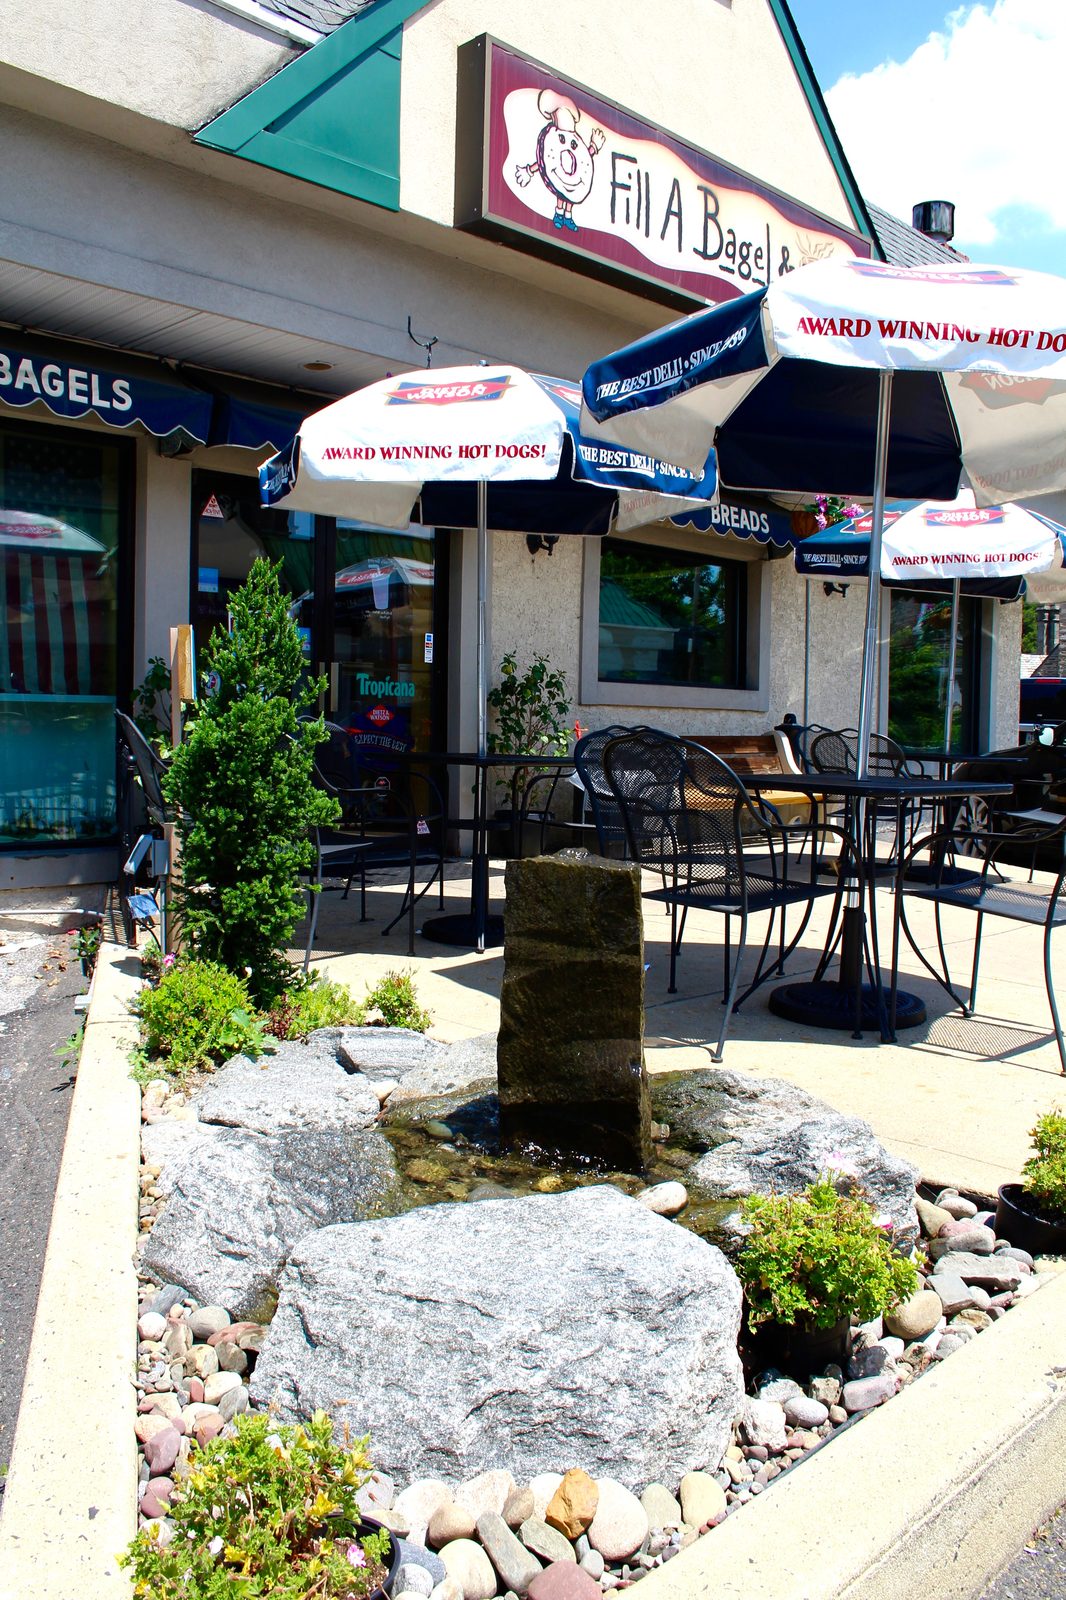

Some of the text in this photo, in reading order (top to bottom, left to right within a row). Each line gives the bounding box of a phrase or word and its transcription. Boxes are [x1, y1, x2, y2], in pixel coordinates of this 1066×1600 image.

[610, 150, 795, 286] Fill A Bagel &
[796, 317, 872, 338] AWARD
[877, 319, 980, 343] WINNING
[987, 327, 1034, 349] HOT
[0, 352, 133, 411] BAGELS
[595, 379, 619, 402] THE
[619, 370, 653, 394] BEST
[653, 356, 684, 385] DELI!
[689, 341, 723, 370] SINCE
[321, 444, 546, 460] AWARD WINNING HOT DOGS!
[578, 444, 598, 463] THE
[598, 448, 629, 467] BEST
[629, 452, 655, 473] DELI!
[659, 461, 688, 479] SINCE
[711, 503, 770, 534] BREADS
[892, 556, 928, 566] AWARD
[931, 554, 981, 564] WINNING
[984, 553, 1006, 563] HOT
